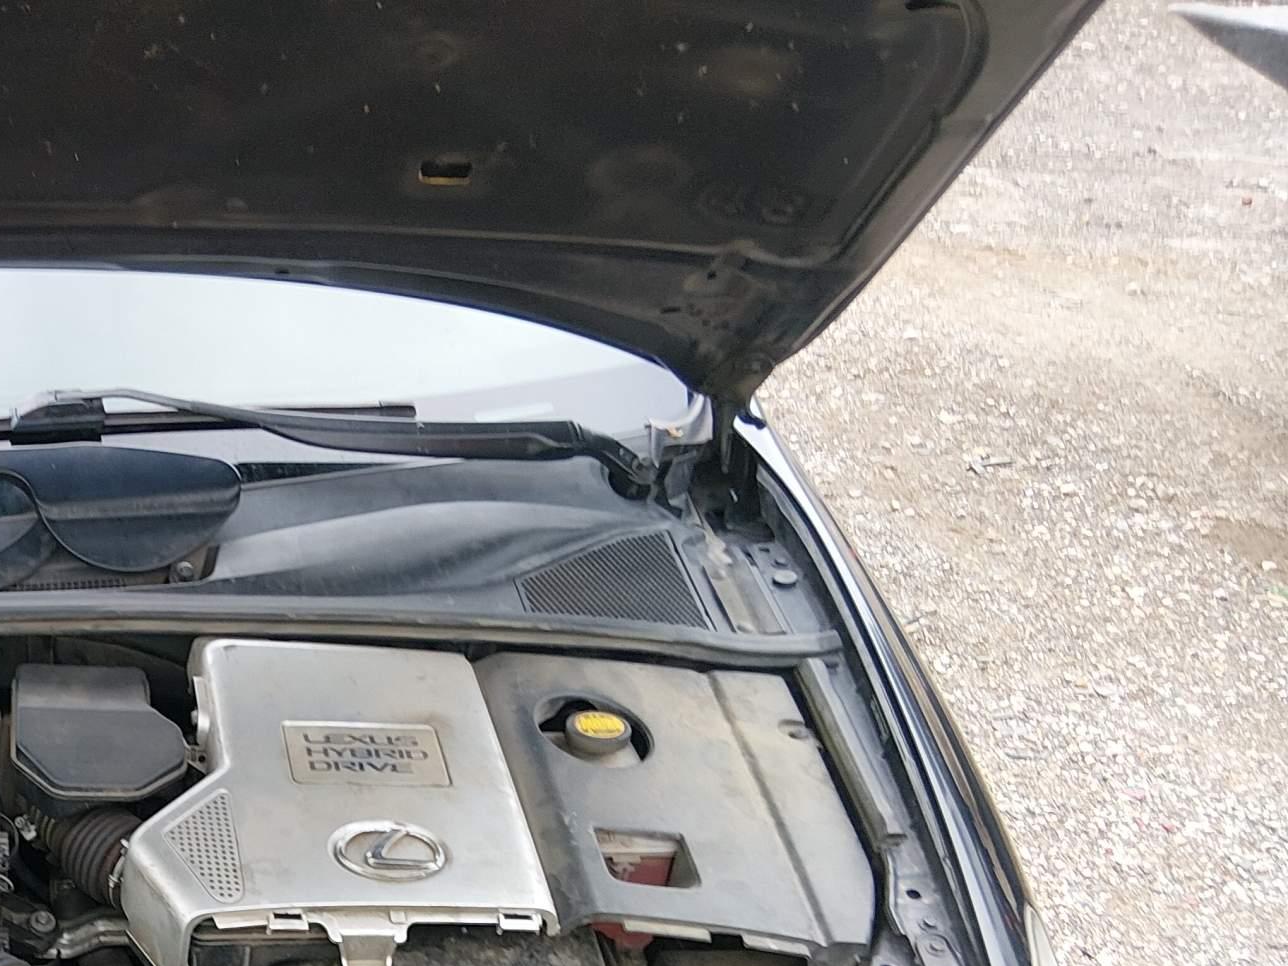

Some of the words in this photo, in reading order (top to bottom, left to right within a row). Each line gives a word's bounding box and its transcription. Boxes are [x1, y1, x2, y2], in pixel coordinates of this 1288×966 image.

[302, 732, 419, 747] LEXUS
[304, 746, 429, 761] HYBRID
[307, 760, 415, 774] DRIVE
